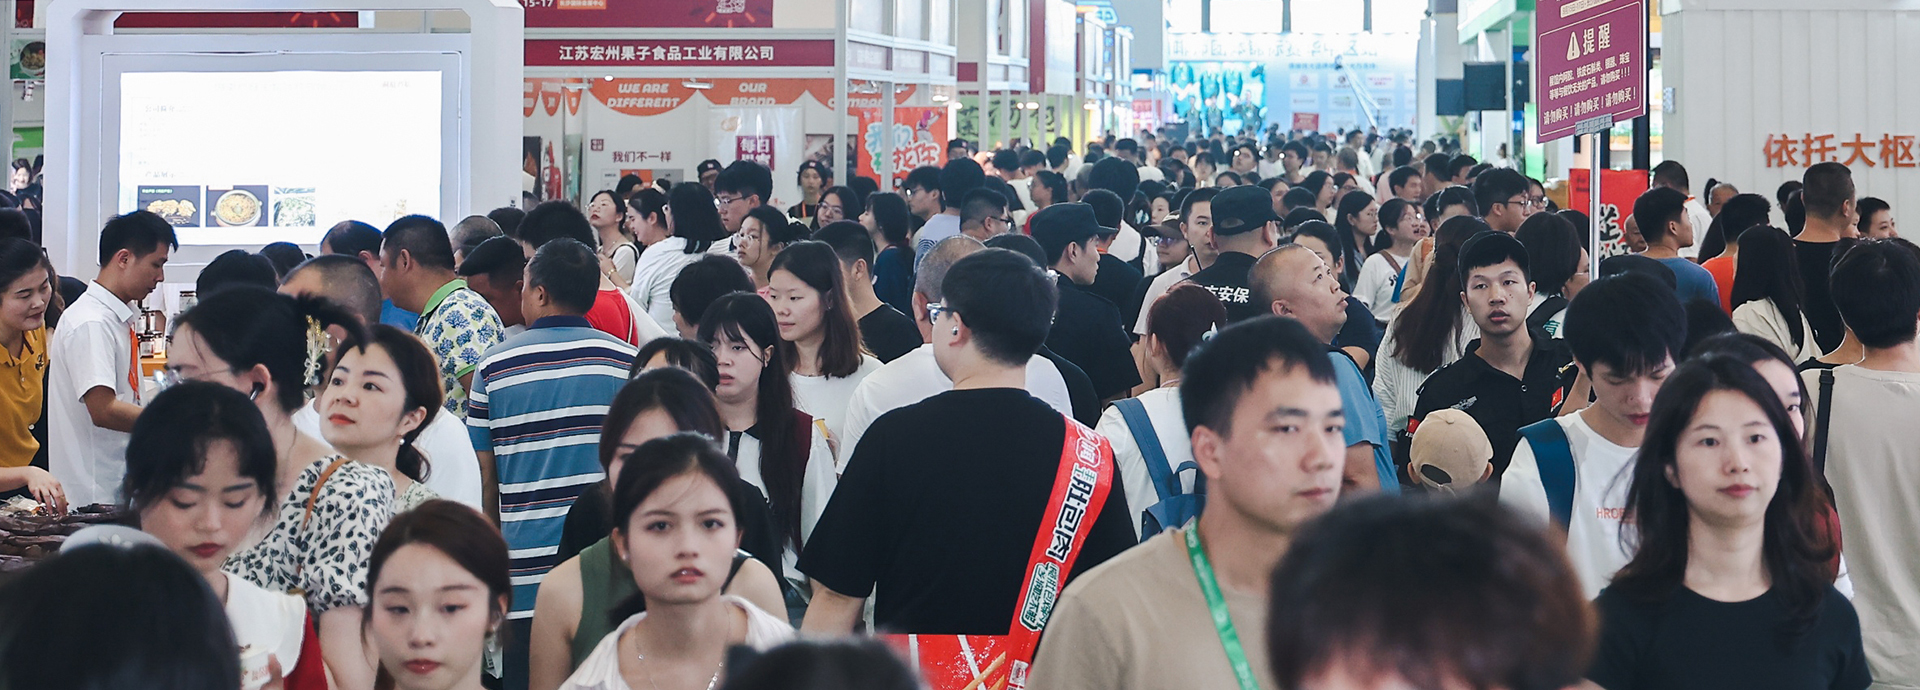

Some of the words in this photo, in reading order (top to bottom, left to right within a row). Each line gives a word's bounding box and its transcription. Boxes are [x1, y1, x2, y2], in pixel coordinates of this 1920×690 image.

[1583, 23, 1611, 56] 提醒
[559, 45, 774, 61] 江苏宏州果子食品工业有限公司
[618, 83, 640, 94] WE
[642, 83, 669, 94] ARE
[738, 83, 768, 93] OUR
[607, 97, 680, 108] DIFFERENT
[730, 97, 776, 106] BRAND
[740, 138, 770, 153] 每日
[1763, 133, 1920, 168] 依托大枢
[613, 151, 672, 163] 我们不一样
[1047, 476, 1094, 562] 肚包肉
